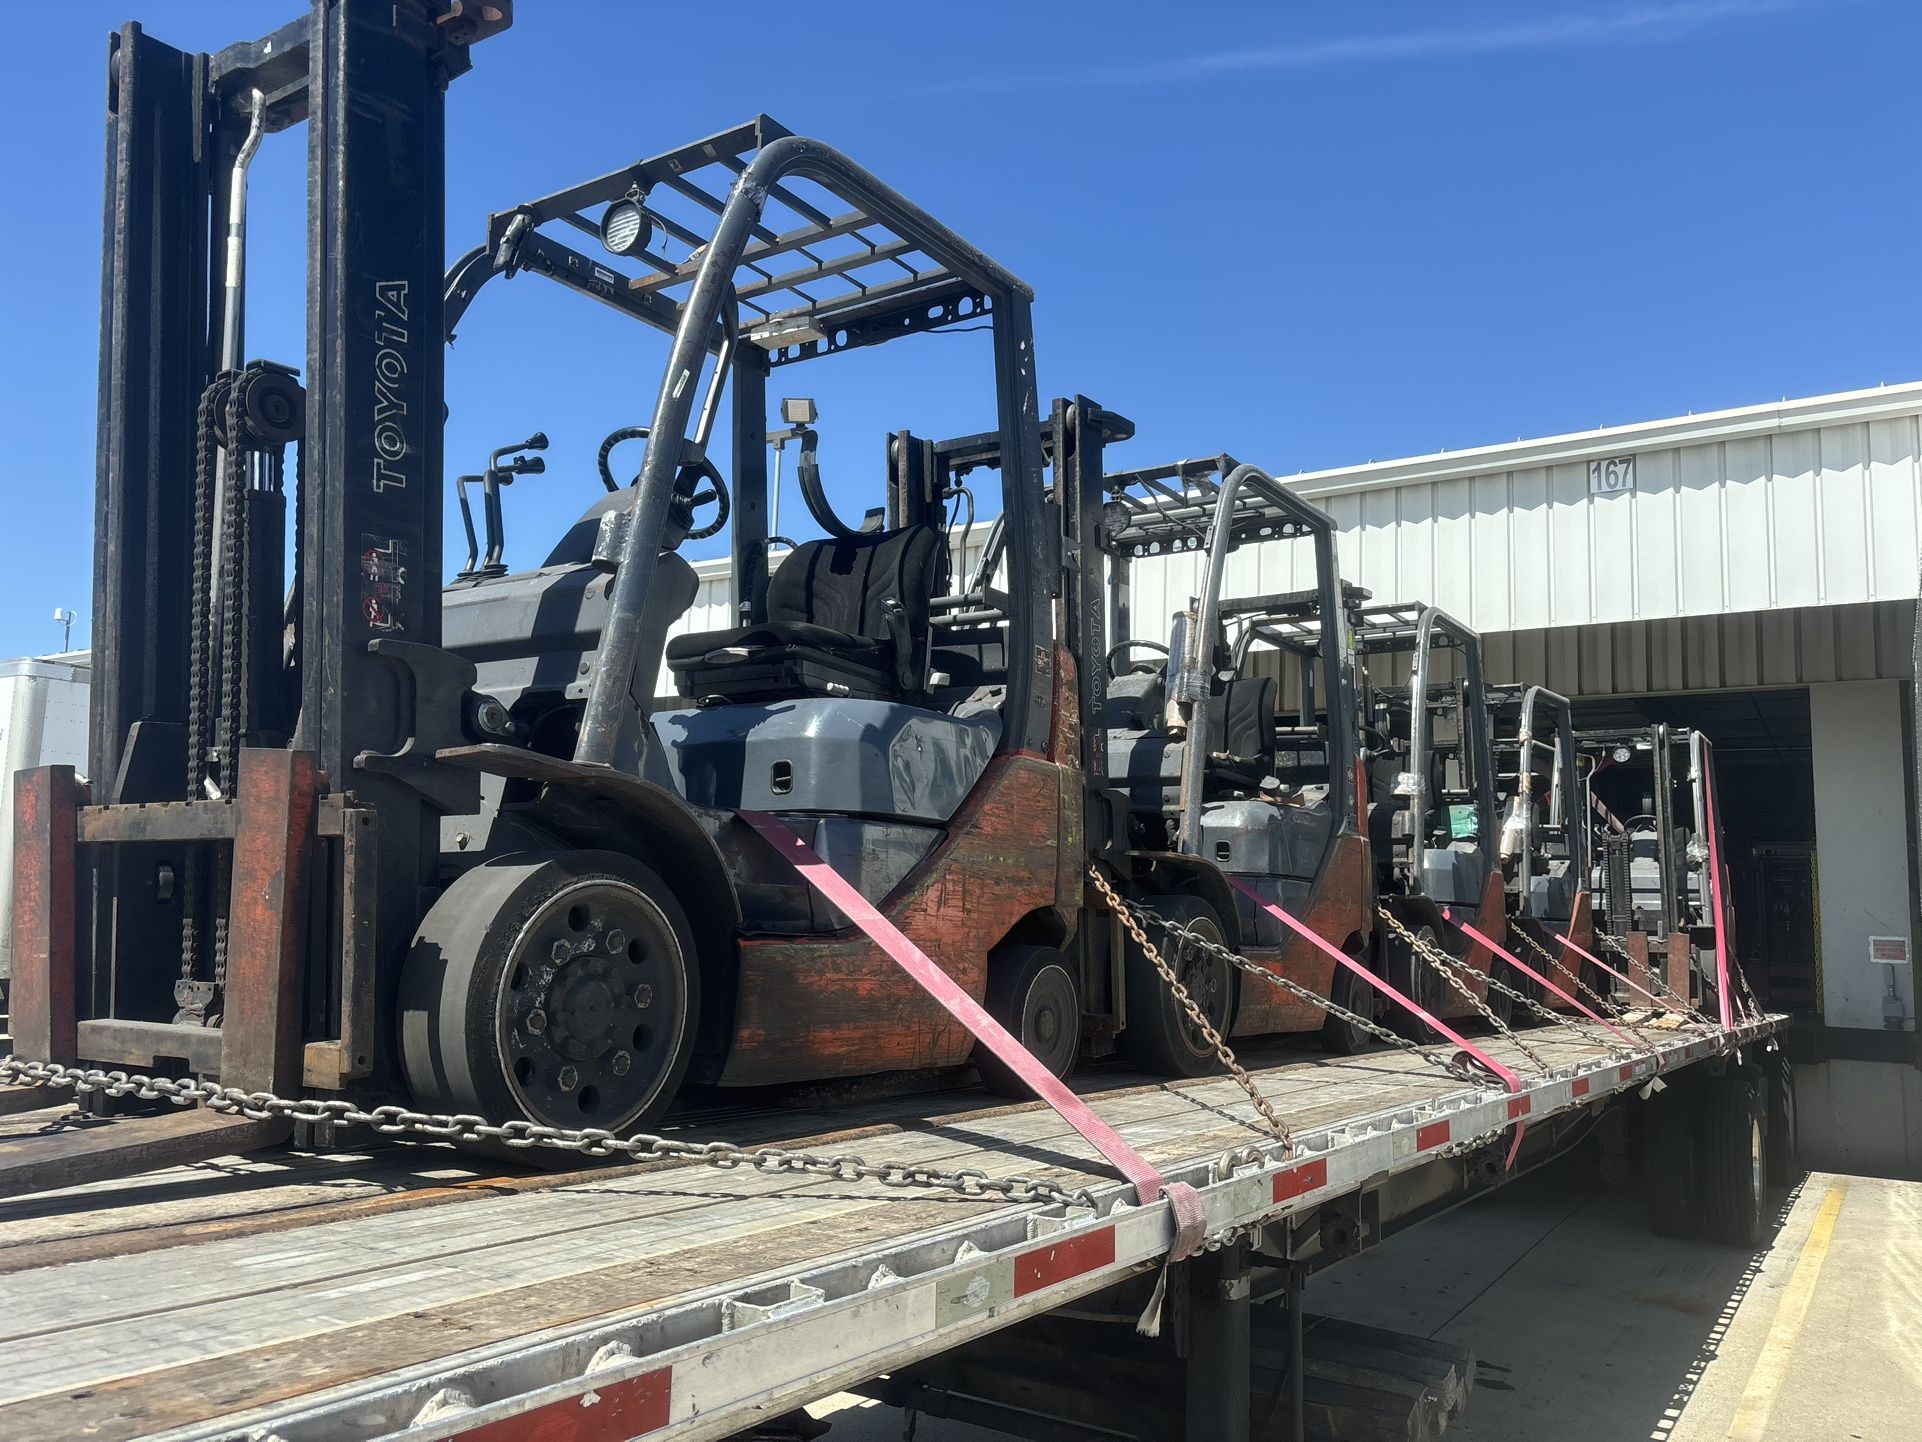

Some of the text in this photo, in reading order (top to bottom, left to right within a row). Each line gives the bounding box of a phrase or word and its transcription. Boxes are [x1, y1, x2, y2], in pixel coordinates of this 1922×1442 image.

[373, 280, 409, 494] TOYOTA
[1592, 458, 1632, 491] 167
[1090, 598, 1102, 715] TOYOTA
